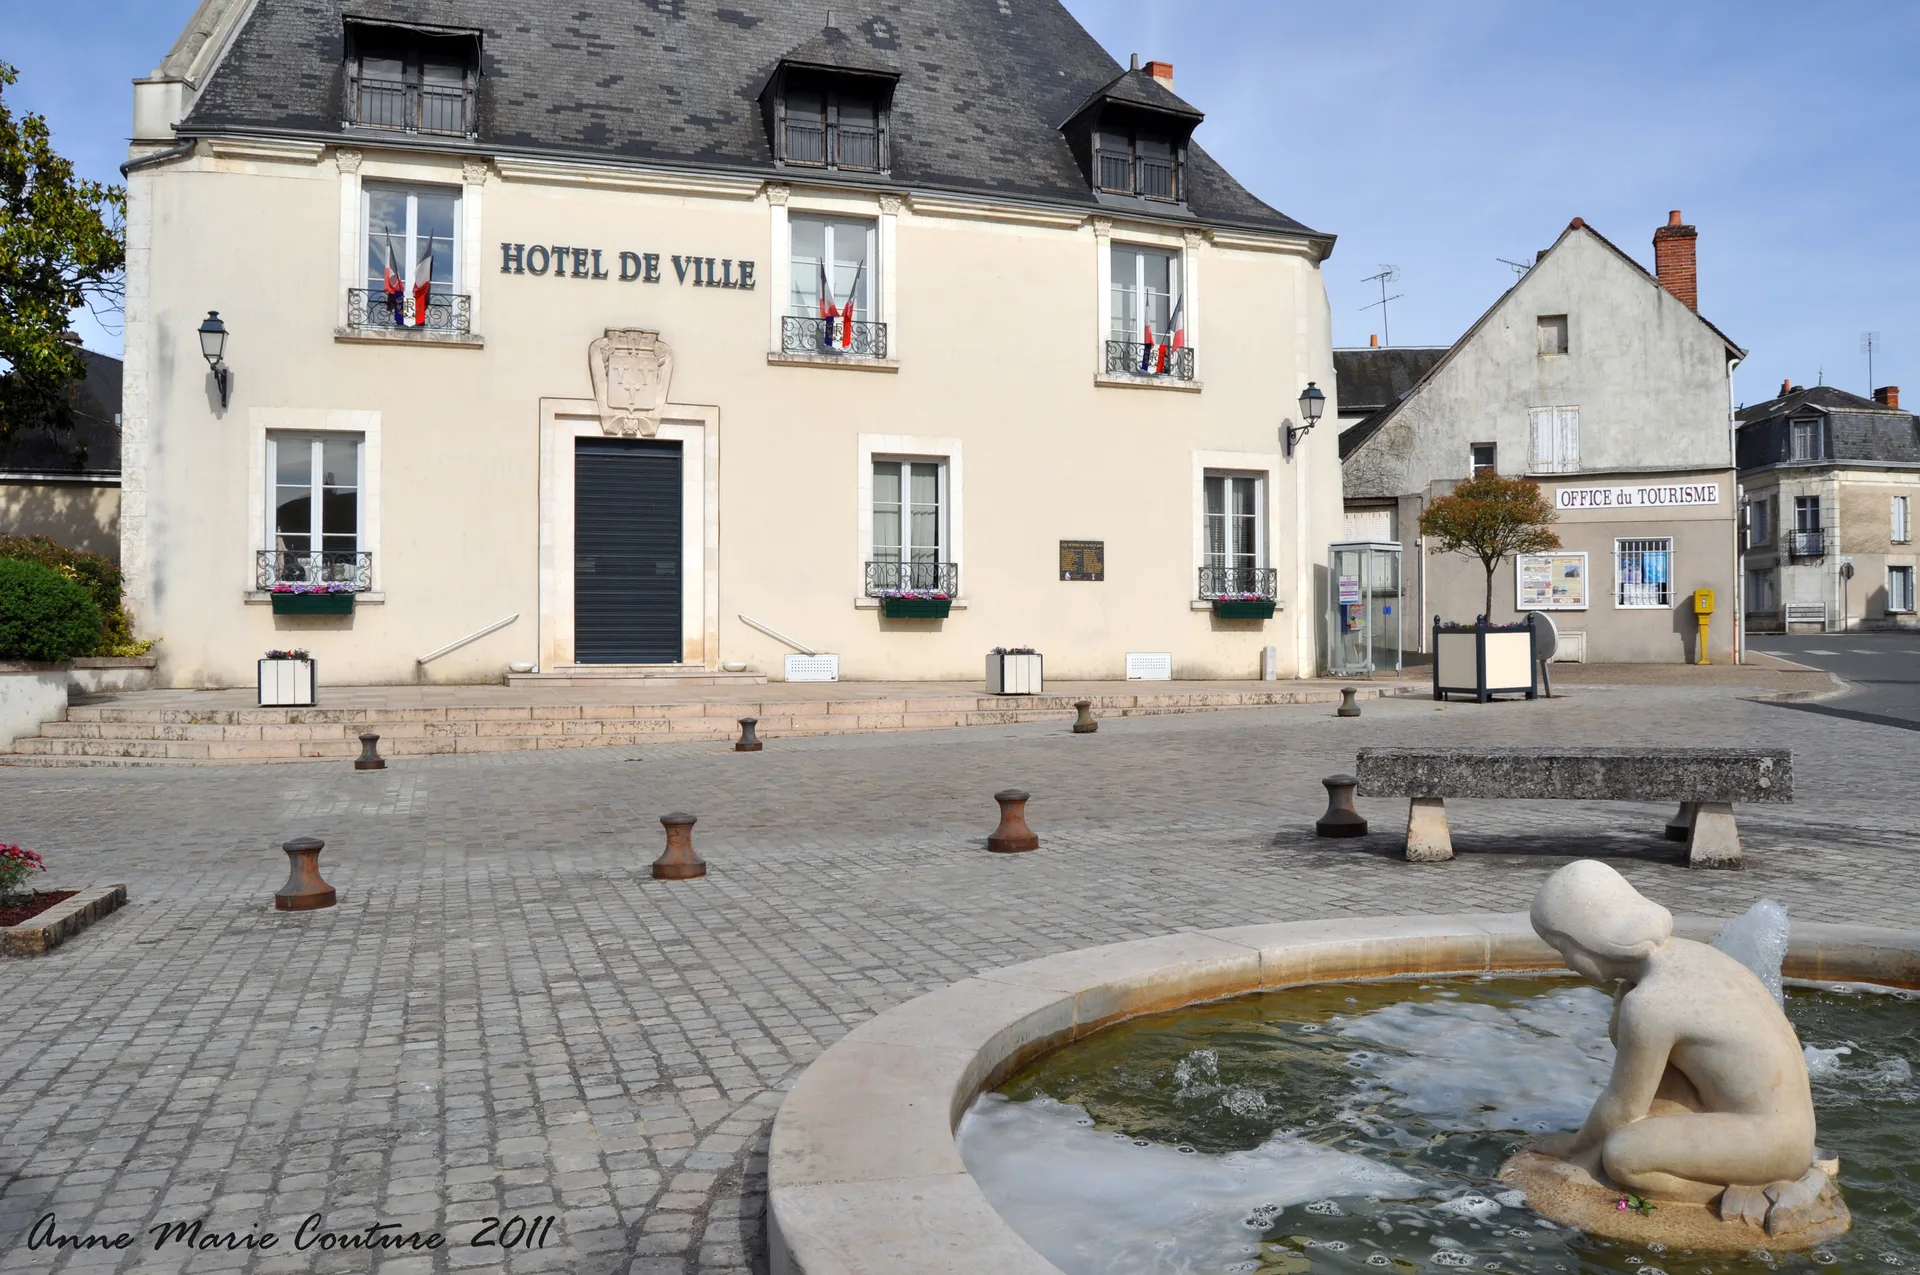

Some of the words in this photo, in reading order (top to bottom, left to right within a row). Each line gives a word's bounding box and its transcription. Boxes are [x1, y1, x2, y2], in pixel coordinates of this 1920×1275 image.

[500, 242, 609, 279] HOTEL
[618, 251, 661, 283] DE
[671, 255, 756, 290] VILLE
[1561, 489, 1612, 507] OFFICE
[1616, 489, 1632, 505] du
[1638, 485, 1716, 504] TOURISME
